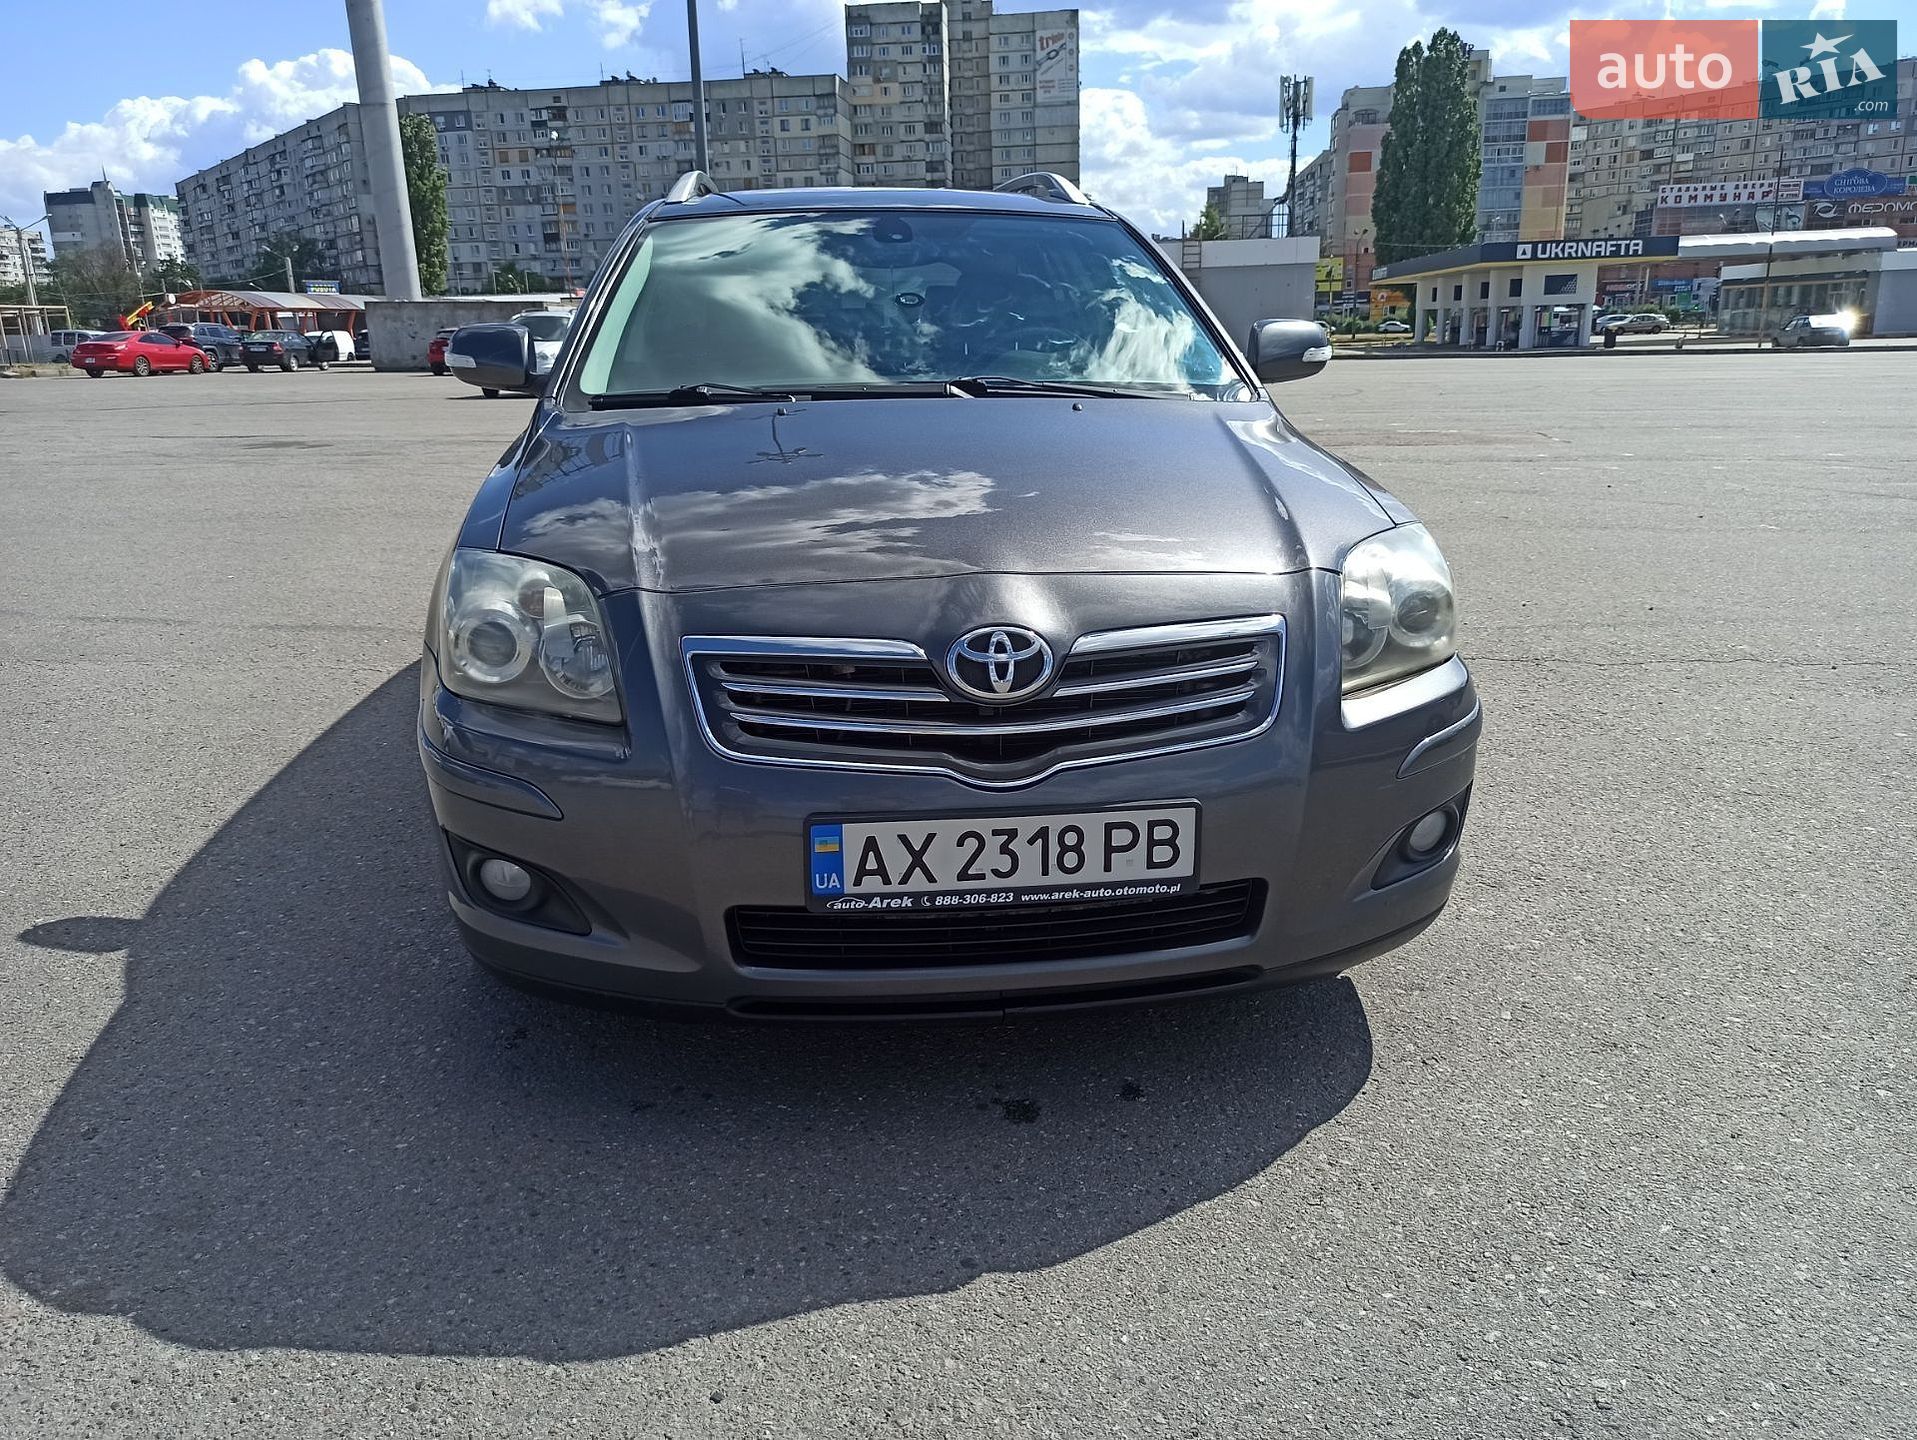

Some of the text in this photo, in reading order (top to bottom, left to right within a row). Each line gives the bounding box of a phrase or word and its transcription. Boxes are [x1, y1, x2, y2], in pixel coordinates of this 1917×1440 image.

[1661, 184, 1726, 194] СТАЛЬНЫЕ
[1734, 182, 1774, 191] ДВЕРИ
[1833, 186, 1876, 194] КОРОЛЕВА
[1660, 189, 1771, 205] КОММУНАР
[1537, 240, 1643, 258] UKRNAFTA
[852, 818, 1181, 887] AX 2318 PB
[815, 873, 841, 889] UA
[832, 883, 1181, 910] auto-Arek 888-306-823 www.arek-auto.otomoto.pl
